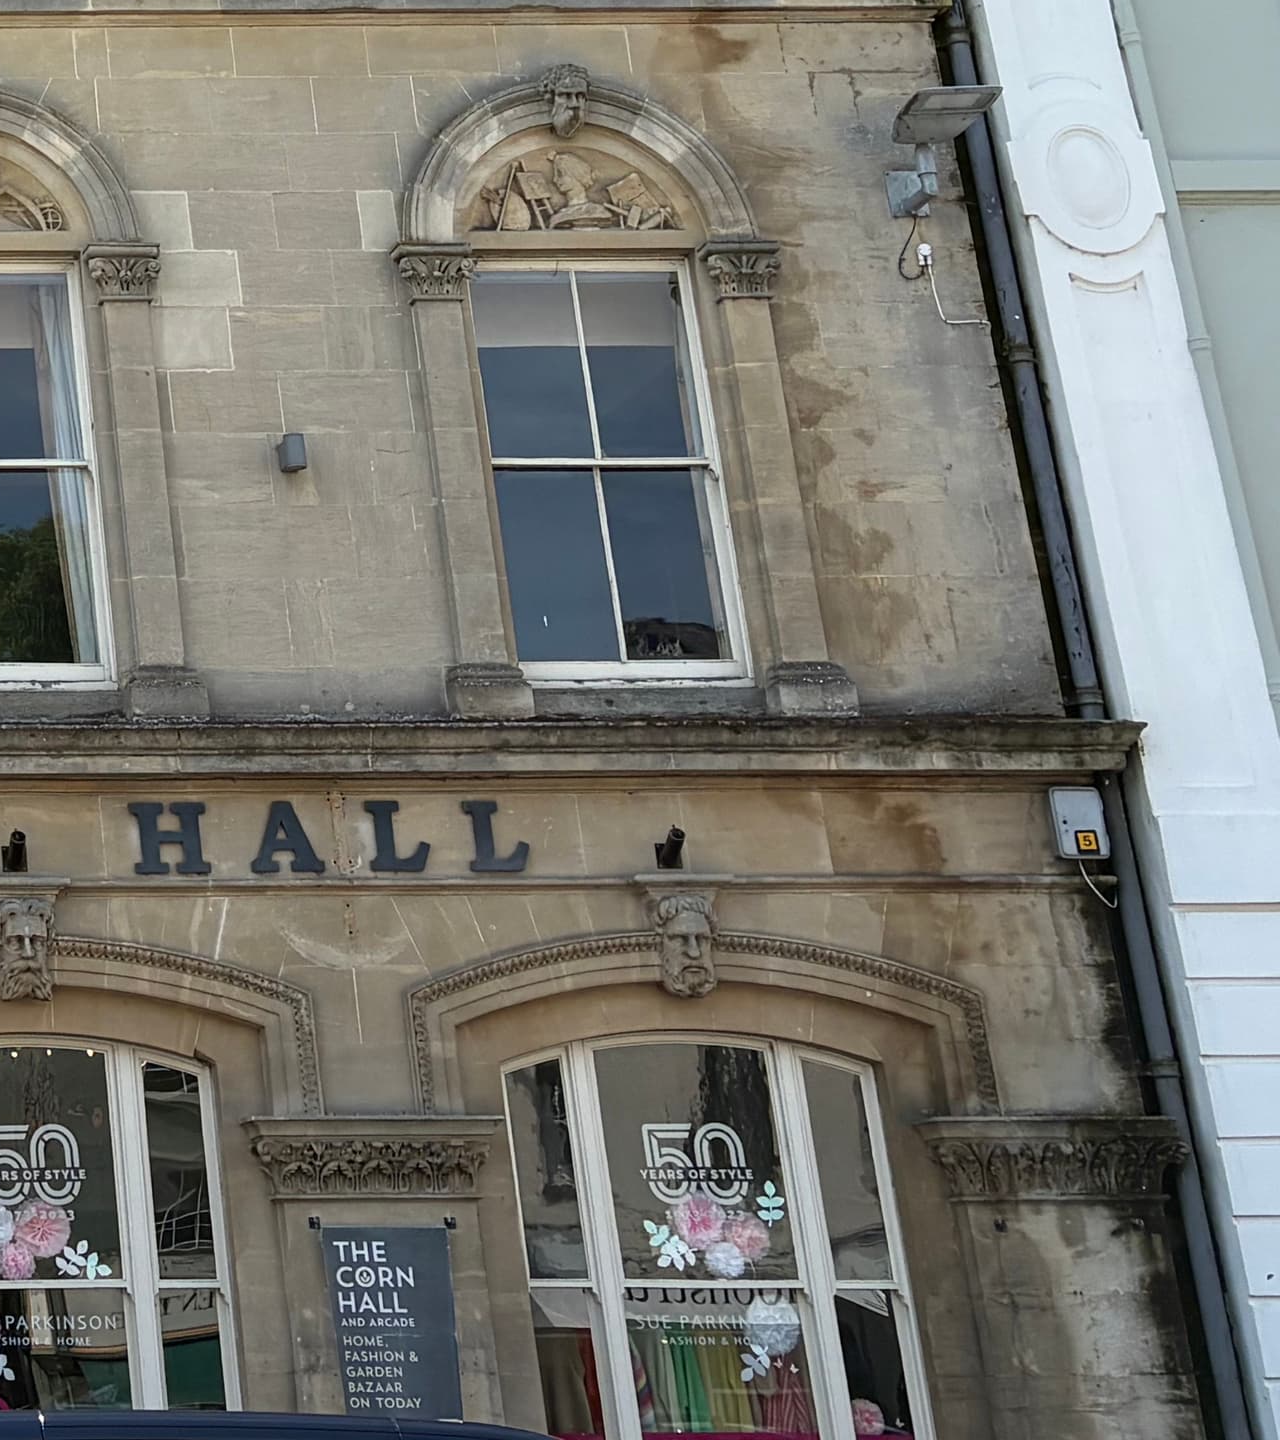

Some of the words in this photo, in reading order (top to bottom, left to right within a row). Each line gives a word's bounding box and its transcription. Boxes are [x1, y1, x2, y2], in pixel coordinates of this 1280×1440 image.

[127, 800, 530, 875] HALL
[1082, 835, 1092, 847] 5
[641, 1122, 748, 1206] 50
[22, 1169, 40, 1180] OF
[44, 1169, 87, 1180] STYLE
[640, 1169, 684, 1180] YEARS
[688, 1169, 706, 1180] OF
[710, 1169, 754, 1180] STYLE
[332, 1241, 387, 1262] THE
[336, 1266, 415, 1288] CORN
[337, 1291, 408, 1313] HALL
[5, 1315, 118, 1330] PARKINSON
[341, 1318, 365, 1327] AND
[369, 1318, 416, 1328] ARCADE
[636, 1315, 673, 1330] SUE
[56, 1337, 92, 1347] HOME
[669, 1336, 716, 1346] ASHION
[344, 1351, 405, 1362] FASHION
[409, 1351, 419, 1362] &
[346, 1366, 403, 1378] GARDEN
[348, 1382, 403, 1393] BAZAAR
[349, 1397, 371, 1408] ON
[375, 1397, 422, 1409] TODAY
